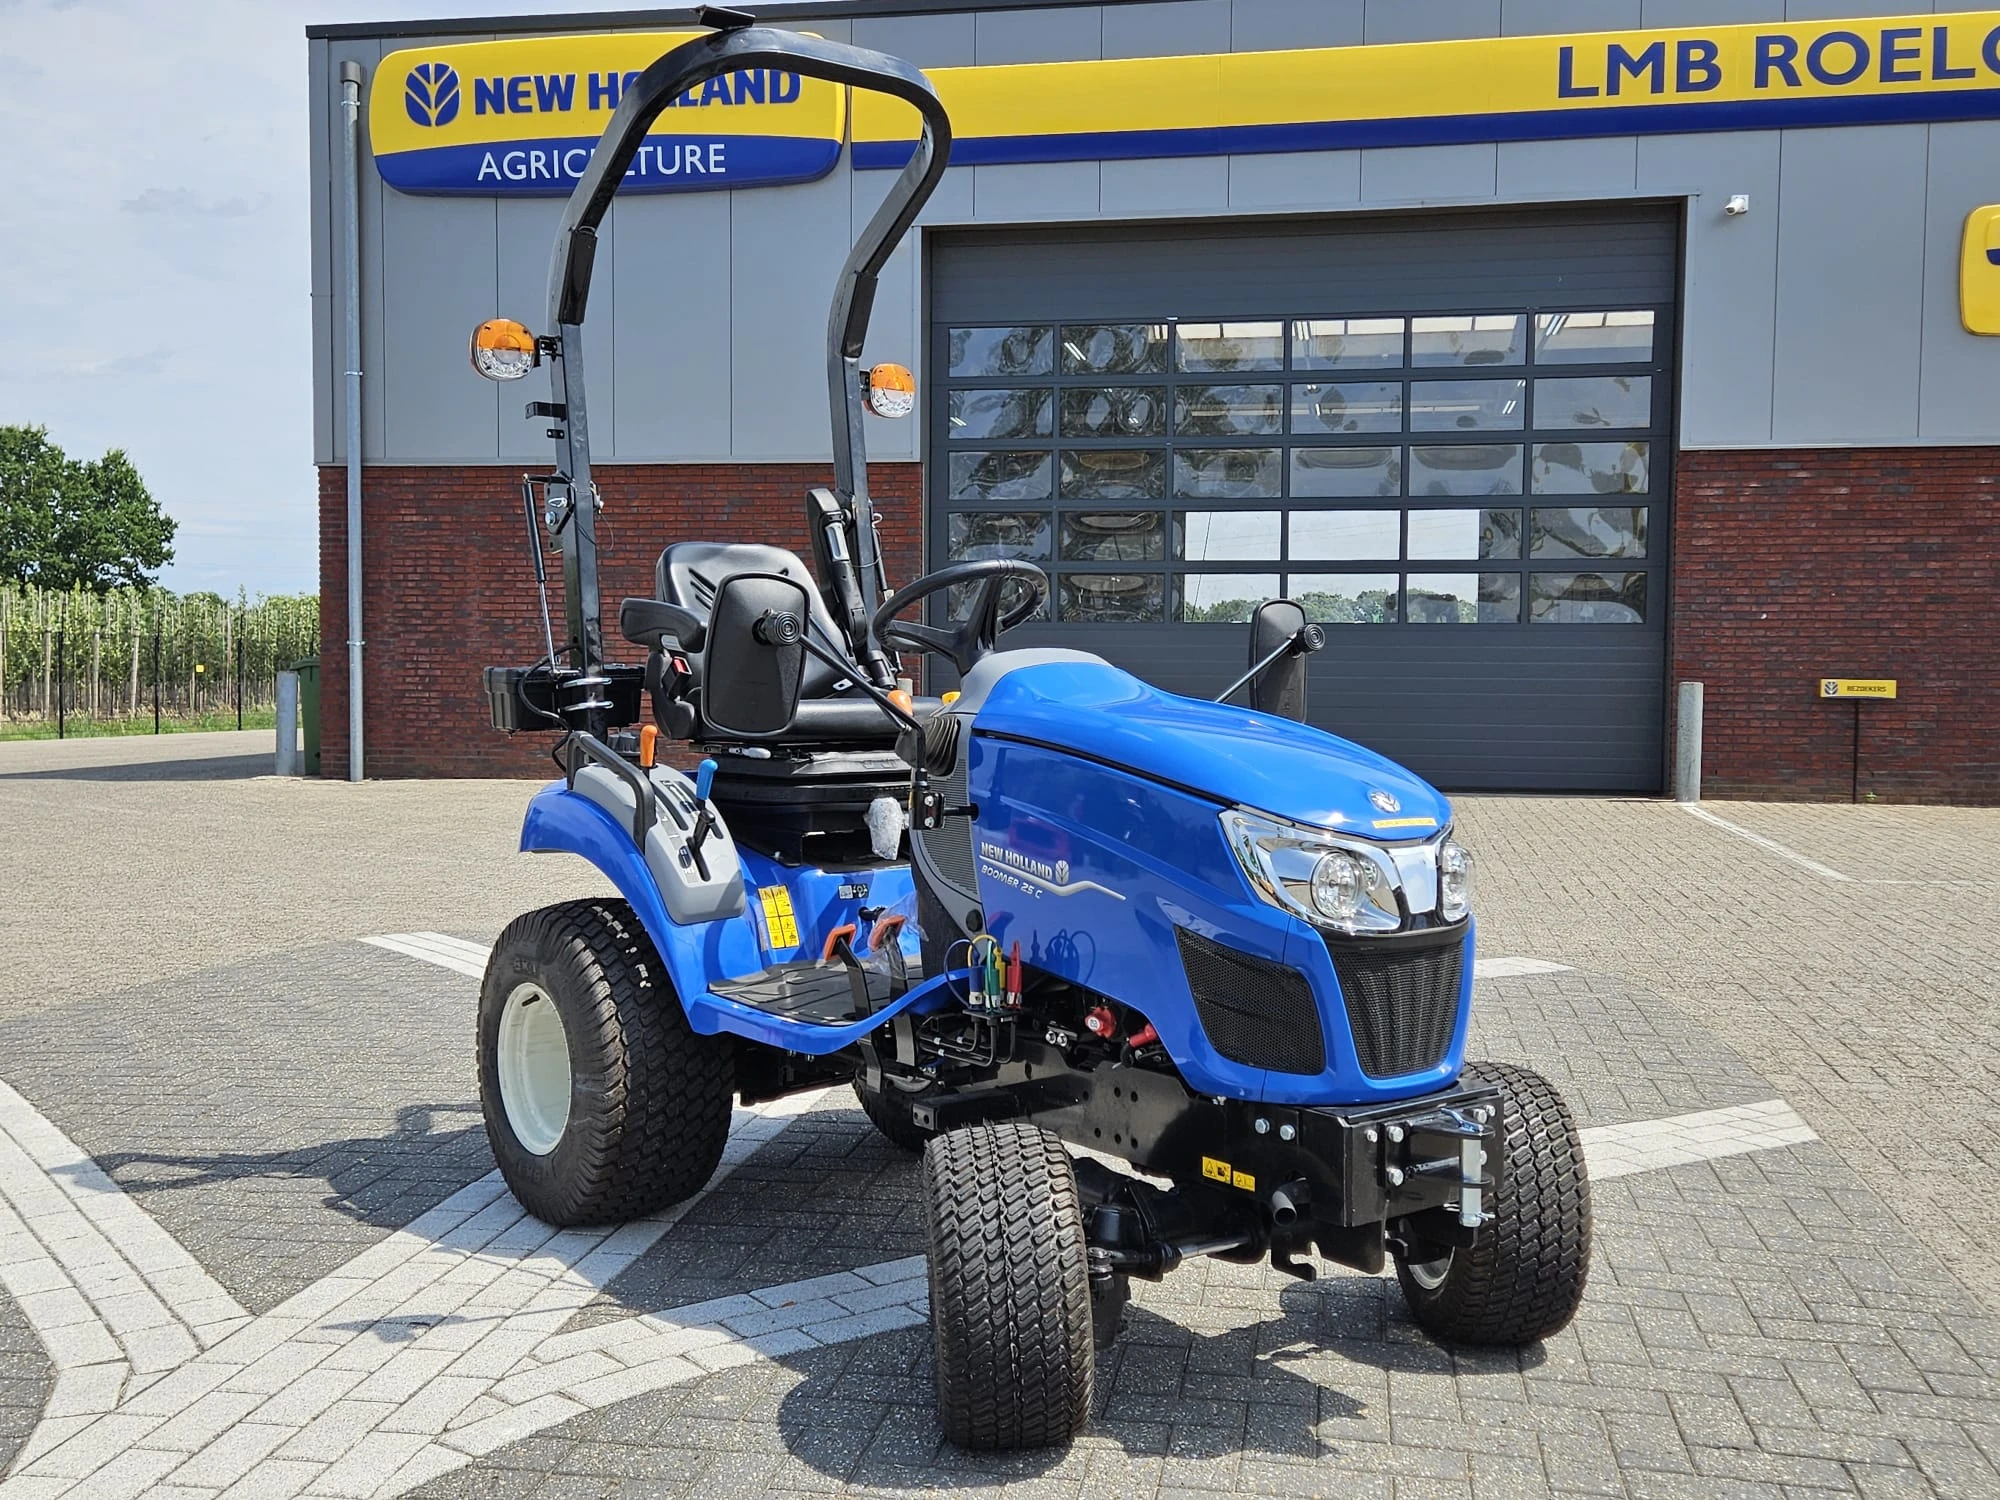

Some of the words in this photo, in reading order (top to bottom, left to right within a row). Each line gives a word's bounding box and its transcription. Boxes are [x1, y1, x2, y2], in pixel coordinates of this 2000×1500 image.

[1558, 39, 1722, 98] LMB
[1754, 25, 2000, 89] ROEL
[474, 73, 576, 115] NEW
[588, 68, 801, 111] HLAND
[477, 143, 726, 181] AGRICTURE
[981, 841, 1003, 861] NEW
[1005, 850, 1053, 881] HOLLAND
[981, 865, 1019, 888] BOOMER
[1020, 882, 1035, 895] 25
[1035, 889, 1043, 899] C
